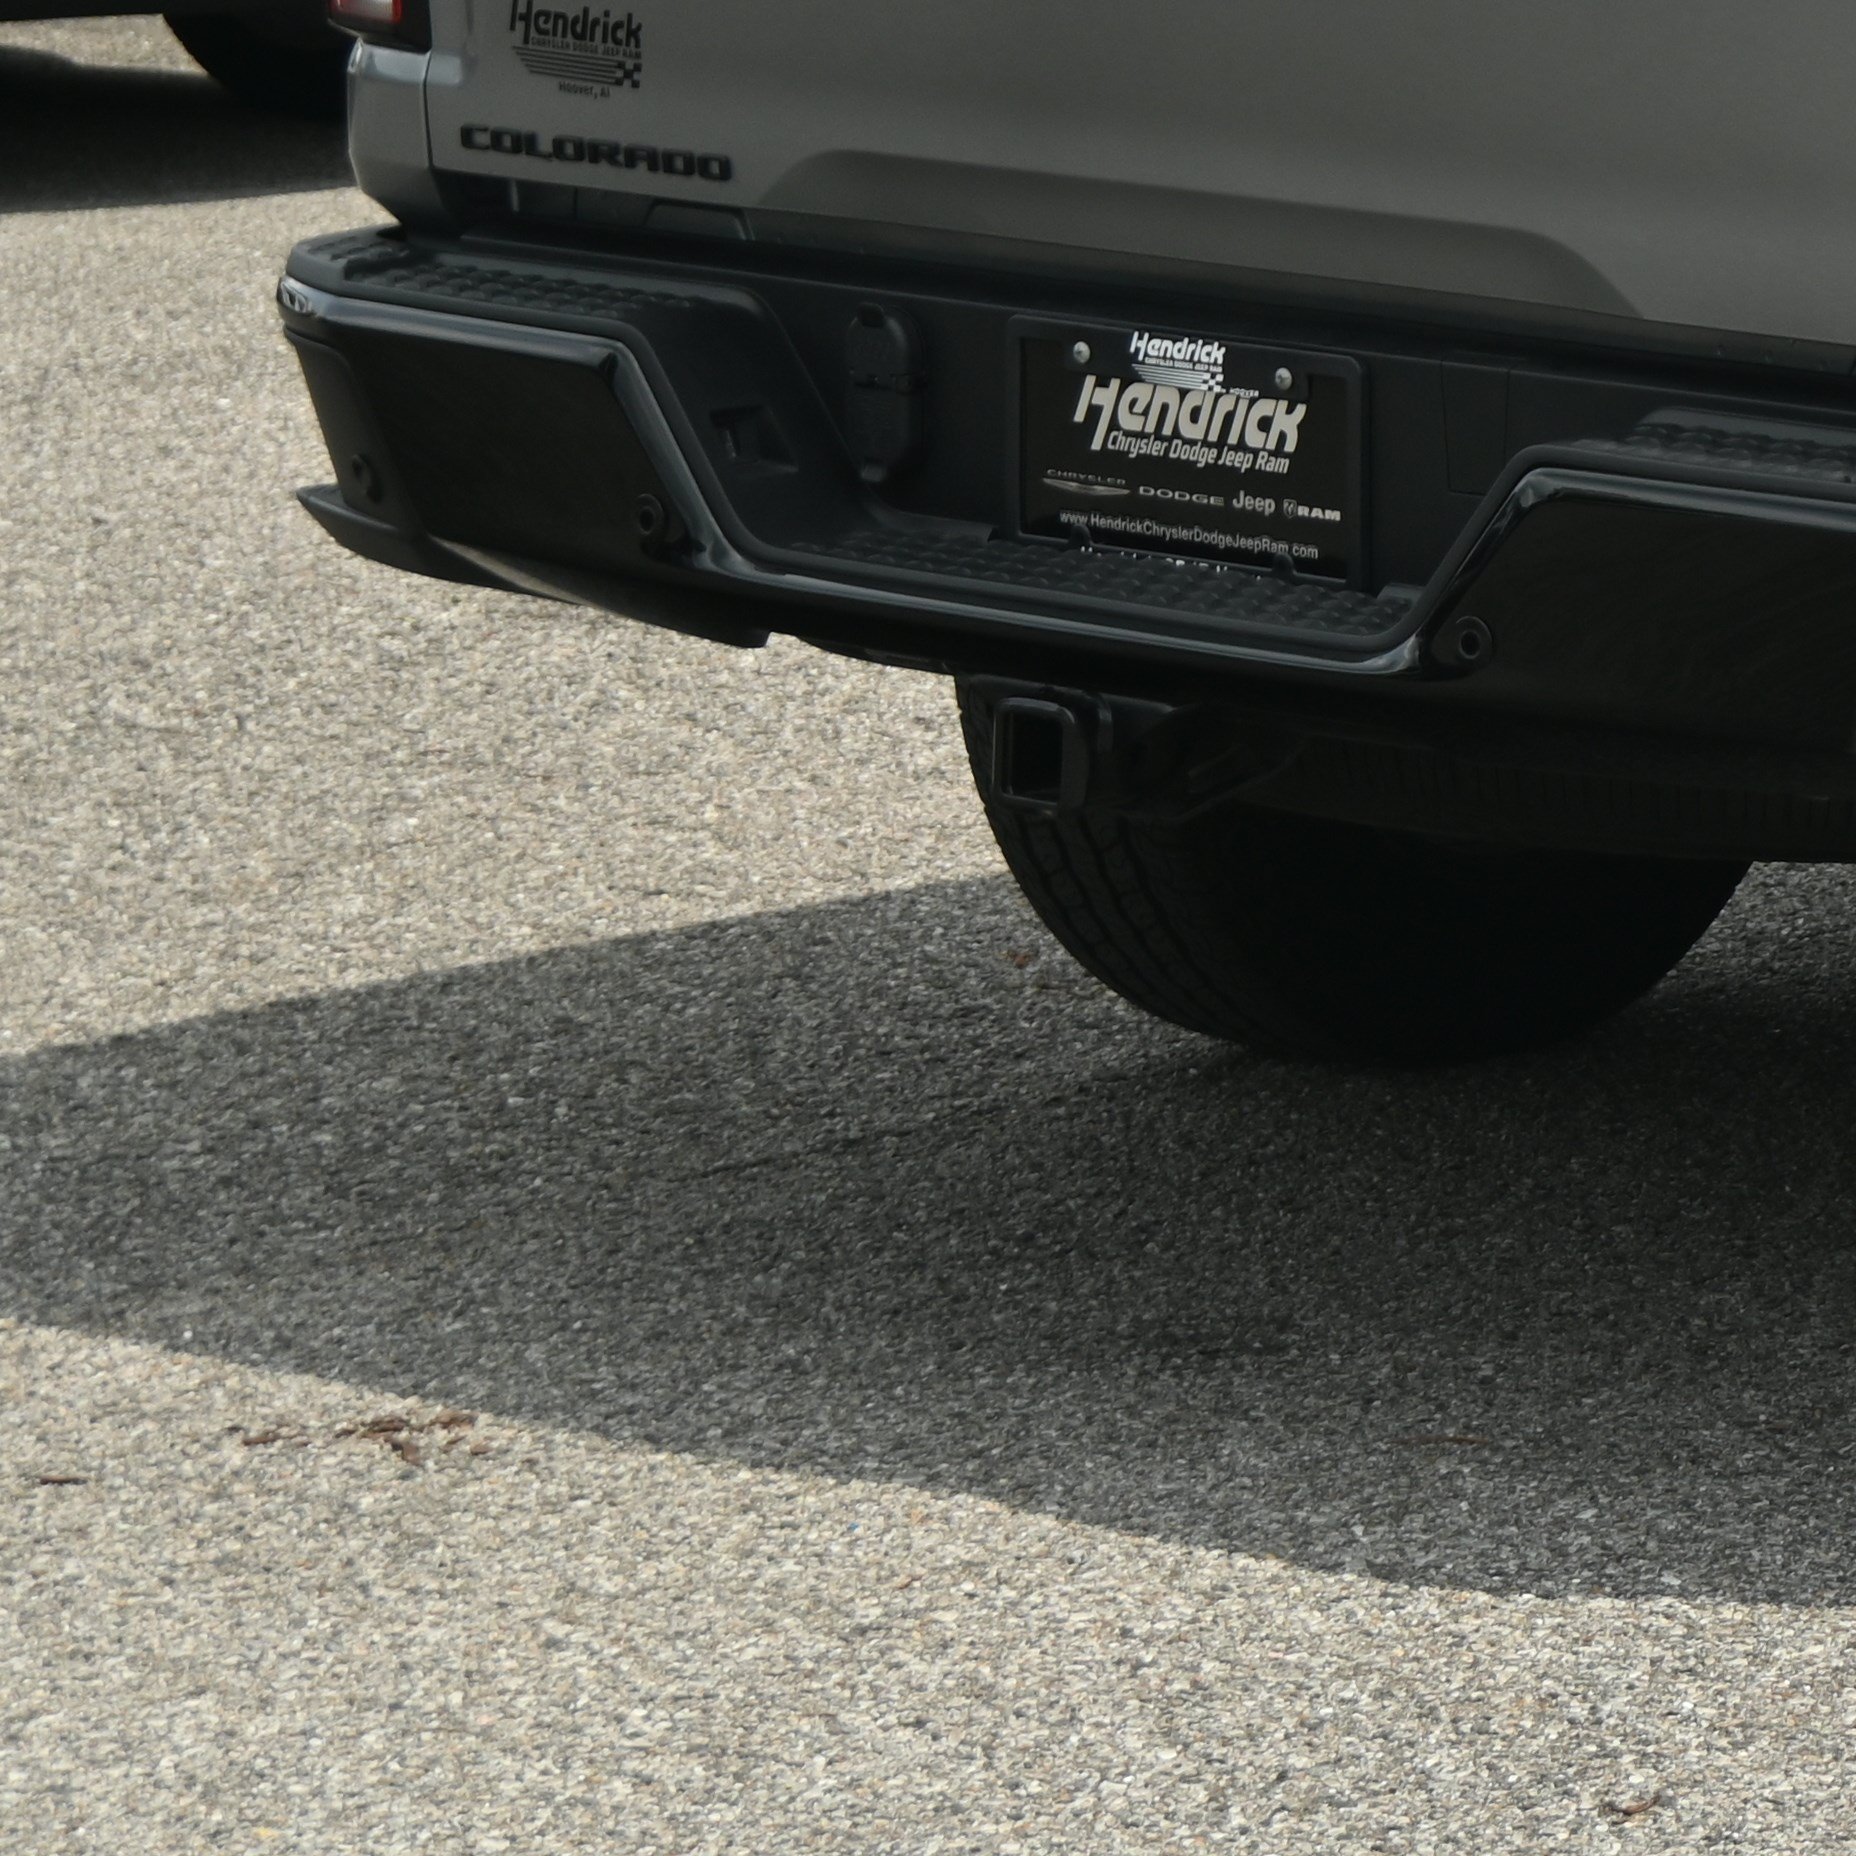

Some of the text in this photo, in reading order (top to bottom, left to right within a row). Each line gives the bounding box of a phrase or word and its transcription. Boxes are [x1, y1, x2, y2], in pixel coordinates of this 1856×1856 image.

[459, 122, 733, 182] COLORADO
[1129, 330, 1226, 365] Hendrick
[1072, 374, 1307, 453] Hendrick
[1106, 430, 1290, 475] Chrysler Dodge Jeep Ram
[1046, 468, 1126, 485] CHRYSLER
[1138, 485, 1225, 507] DODGE
[1232, 489, 1276, 516] Jeep
[1297, 504, 1342, 522] RAM
[1059, 511, 1320, 560] www.HendrickChryslerDodgeJeepRamcom
